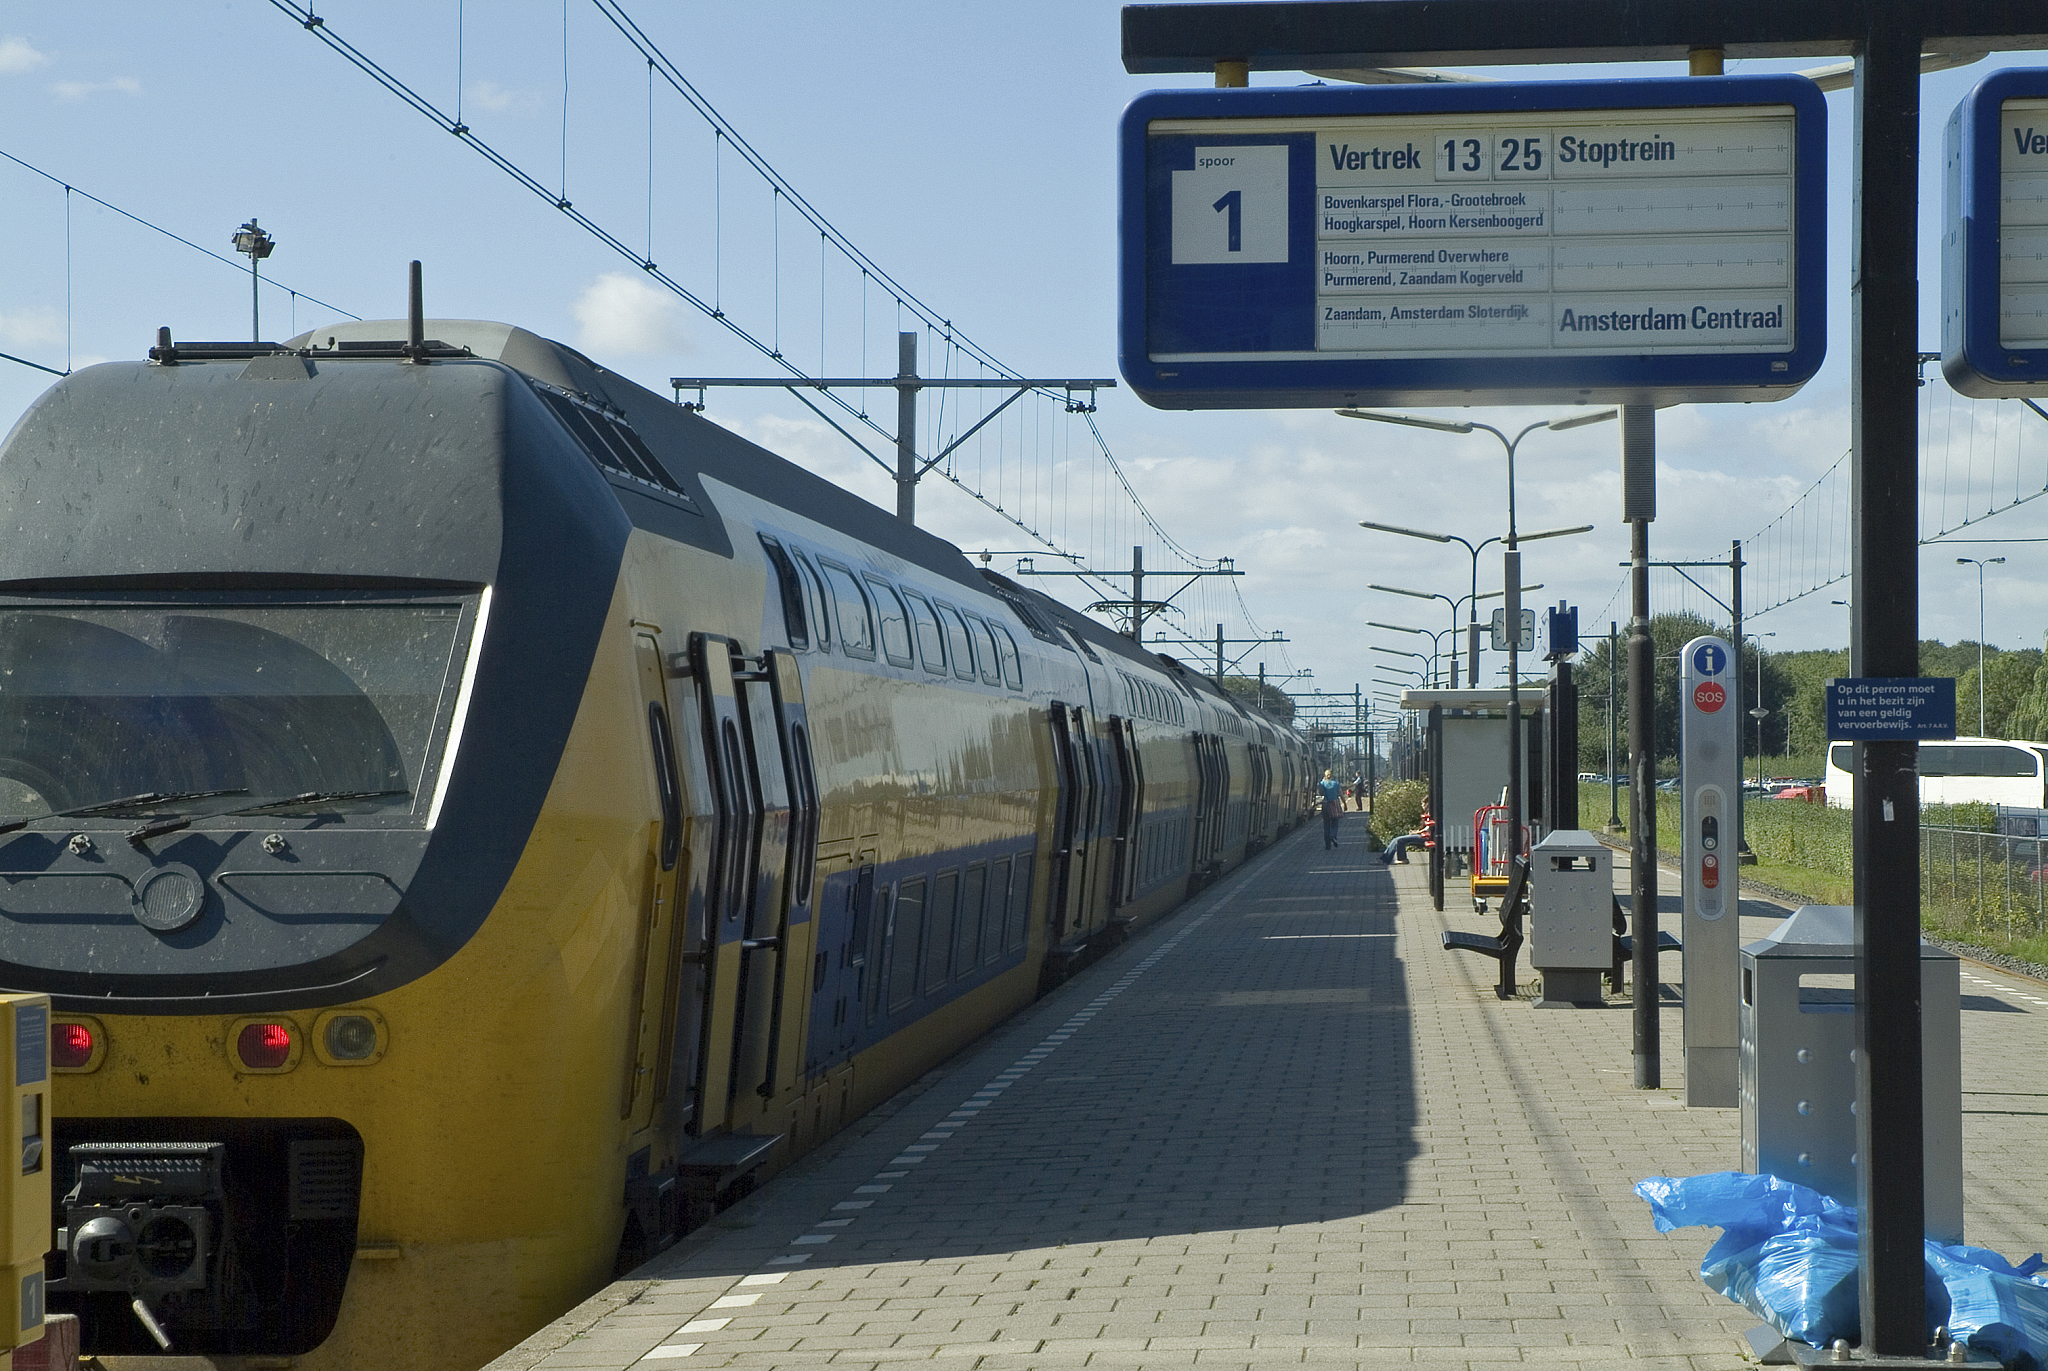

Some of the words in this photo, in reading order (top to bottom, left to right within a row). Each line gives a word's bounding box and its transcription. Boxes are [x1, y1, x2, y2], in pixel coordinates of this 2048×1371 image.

[2013, 127, 2048, 155] Ve
[1330, 143, 1421, 170] Vertrek
[1443, 139, 1482, 172] 13
[1501, 138, 1543, 171] 25
[1559, 134, 1675, 168] Stoptrein
[1199, 156, 1235, 169] spoor
[1325, 195, 1405, 211] Bovenkarspel
[1212, 190, 1242, 252] 1
[1325, 216, 1405, 233] Hoogkarspel,
[1409, 215, 1446, 229] Hoorn
[1450, 213, 1544, 230] Kersenboogerd
[1325, 251, 1364, 265] Hoorn,
[1368, 250, 1434, 264] Purmerend
[1438, 249, 1509, 263] Overwhere
[1325, 272, 1396, 286] Purmerend,
[1400, 271, 1456, 285] Zaandam
[1460, 269, 1523, 287] Kogerveld
[1325, 307, 1386, 321] Zaandam,
[1390, 305, 1464, 319] Amsterdam
[1468, 304, 1529, 320] Sloterdijk
[1560, 307, 1686, 331] Amsterdam
[1692, 305, 1783, 330] Centraal
[1705, 648, 1714, 671] i
[1697, 692, 1723, 703] SOS
[1838, 685, 1853, 696] Op
[1855, 684, 1869, 693] dit
[1872, 686, 1906, 695] perron
[1908, 685, 1935, 693] moet
[1847, 697, 1857, 705] in
[1860, 696, 1876, 705] het
[1879, 696, 1905, 705] bezit
[1907, 696, 1925, 707] zijn
[1838, 709, 1856, 717] van
[1858, 709, 1877, 717] een
[1880, 708, 1912, 719] geldig
[1838, 720, 1912, 731] vervoerbewijs.
[29, 1282, 36, 1319] 1
